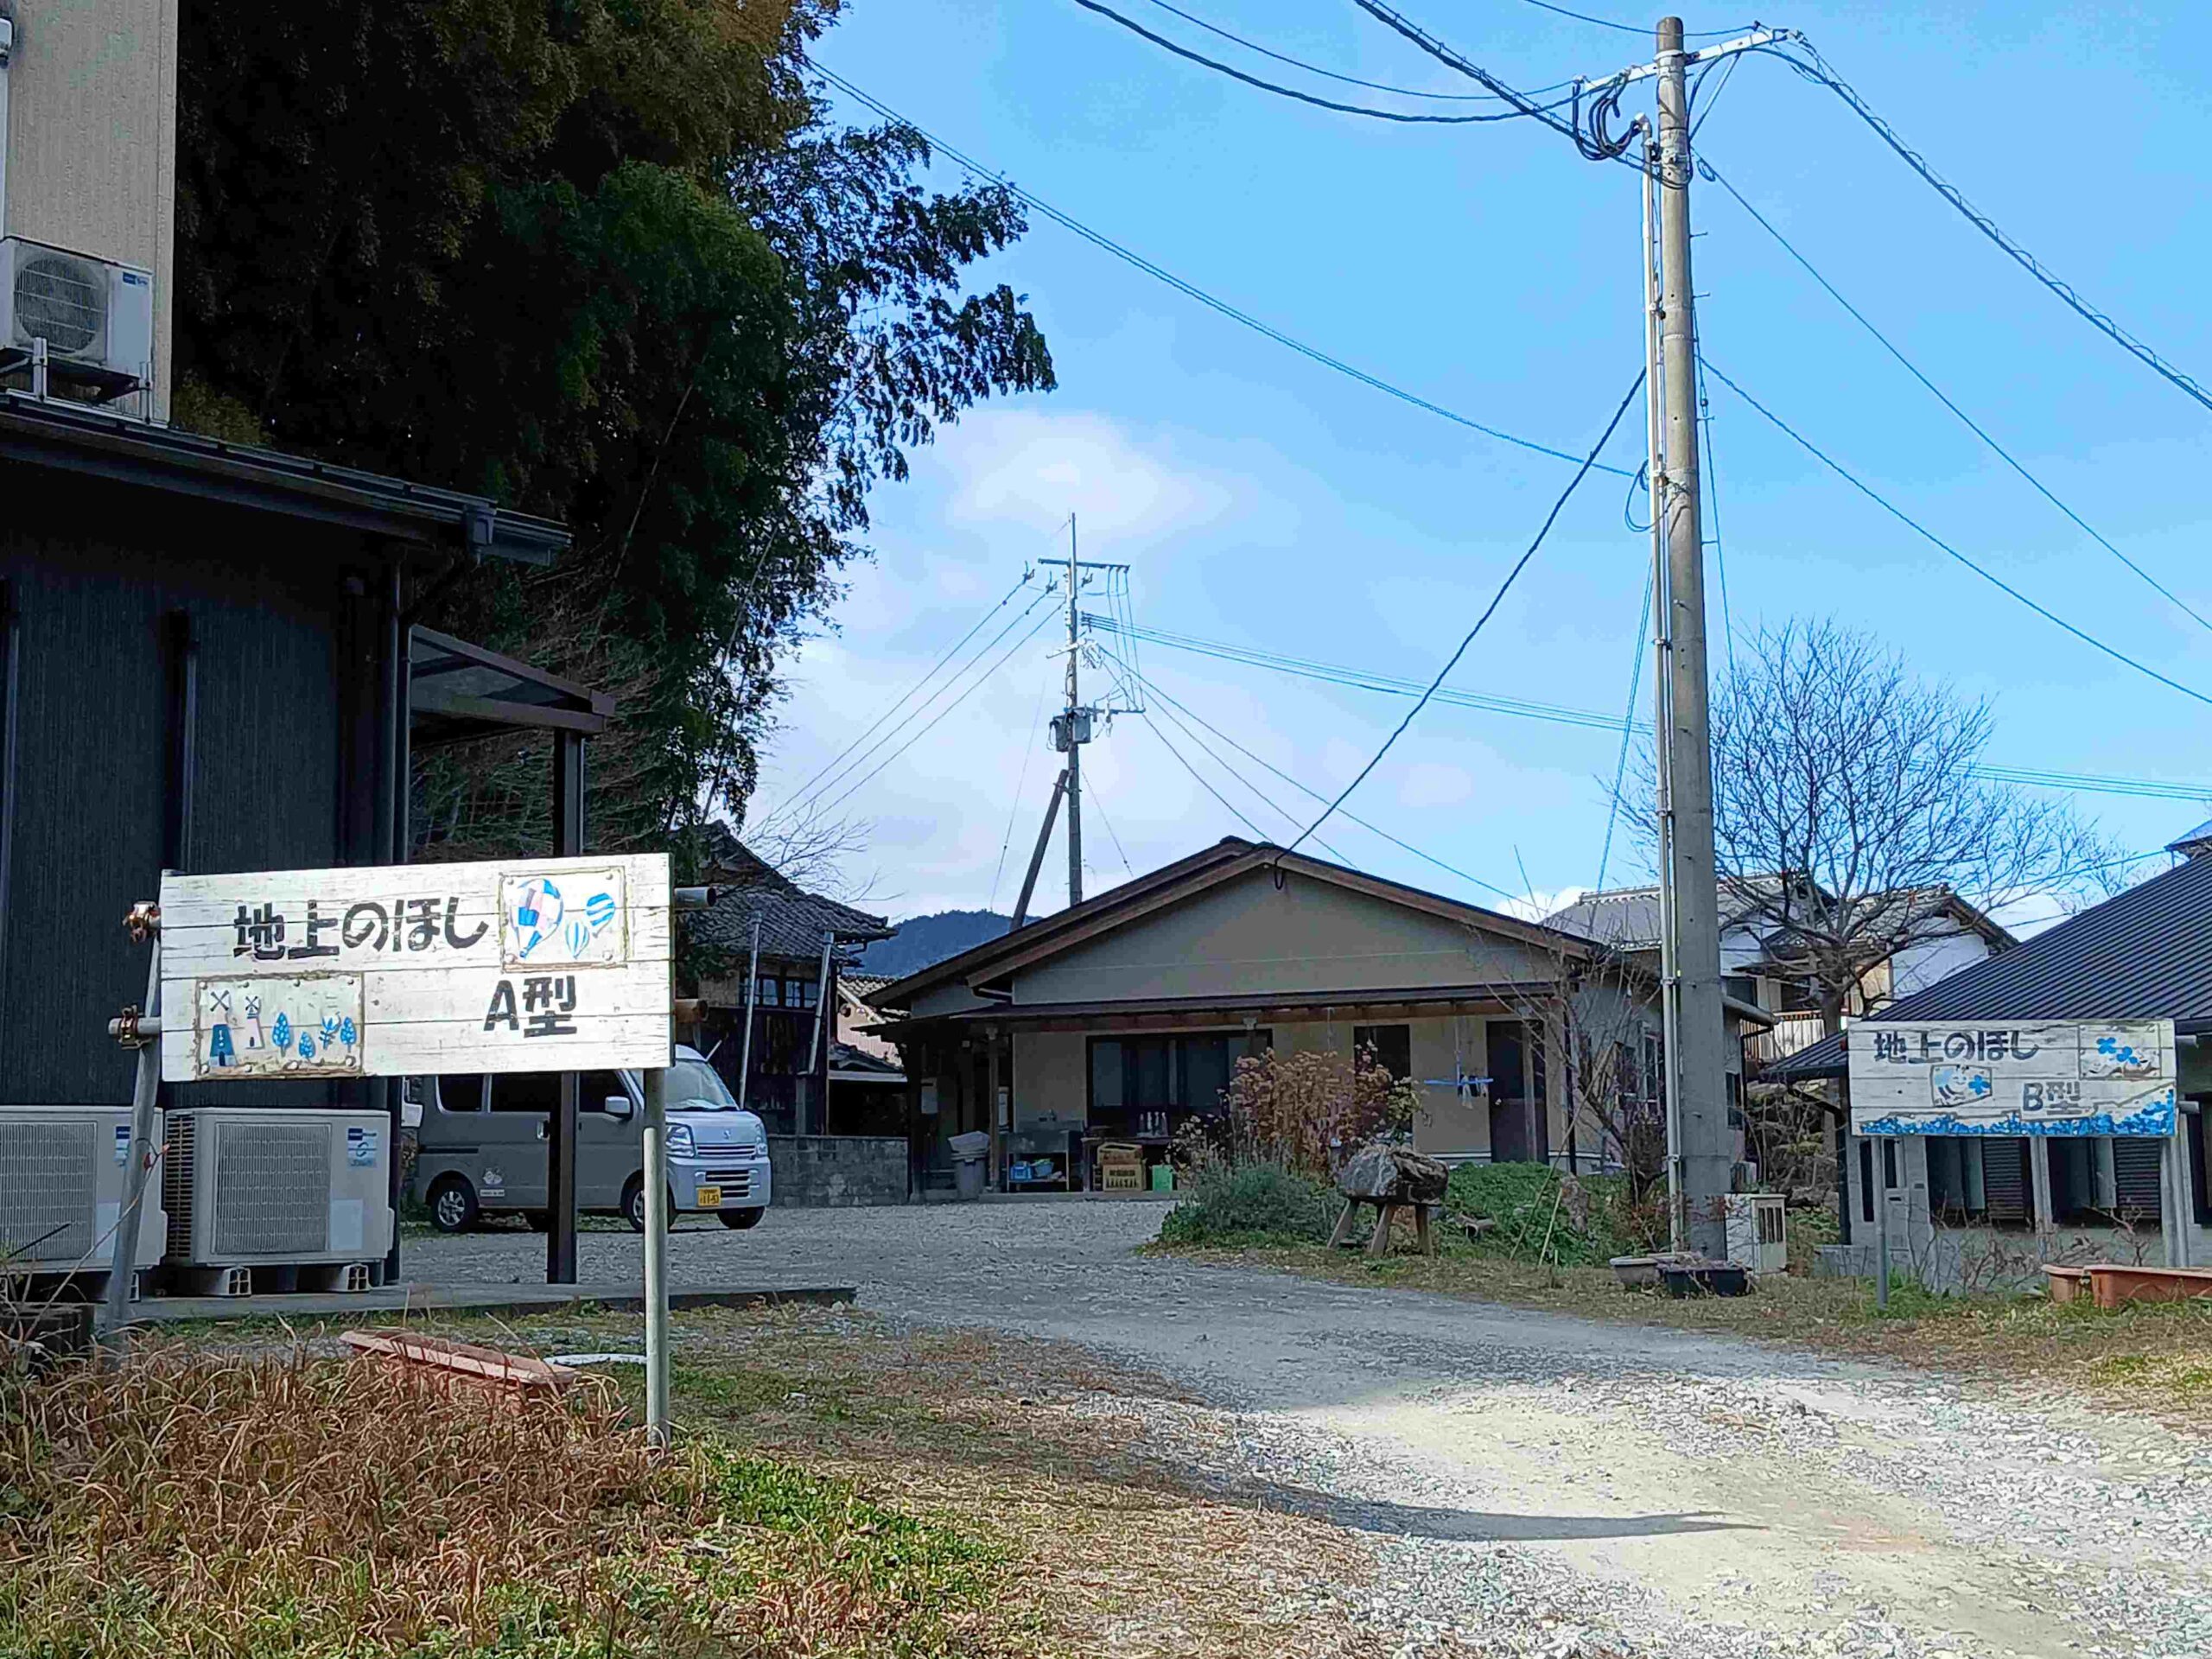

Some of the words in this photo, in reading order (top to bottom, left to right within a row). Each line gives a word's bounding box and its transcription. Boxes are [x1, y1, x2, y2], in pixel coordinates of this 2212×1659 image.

[233, 897, 489, 960] 地上のほし
[484, 976, 578, 1038] A型
[1874, 1031, 2040, 1064] 地上のほし
[2023, 1081, 2082, 1116] B型
